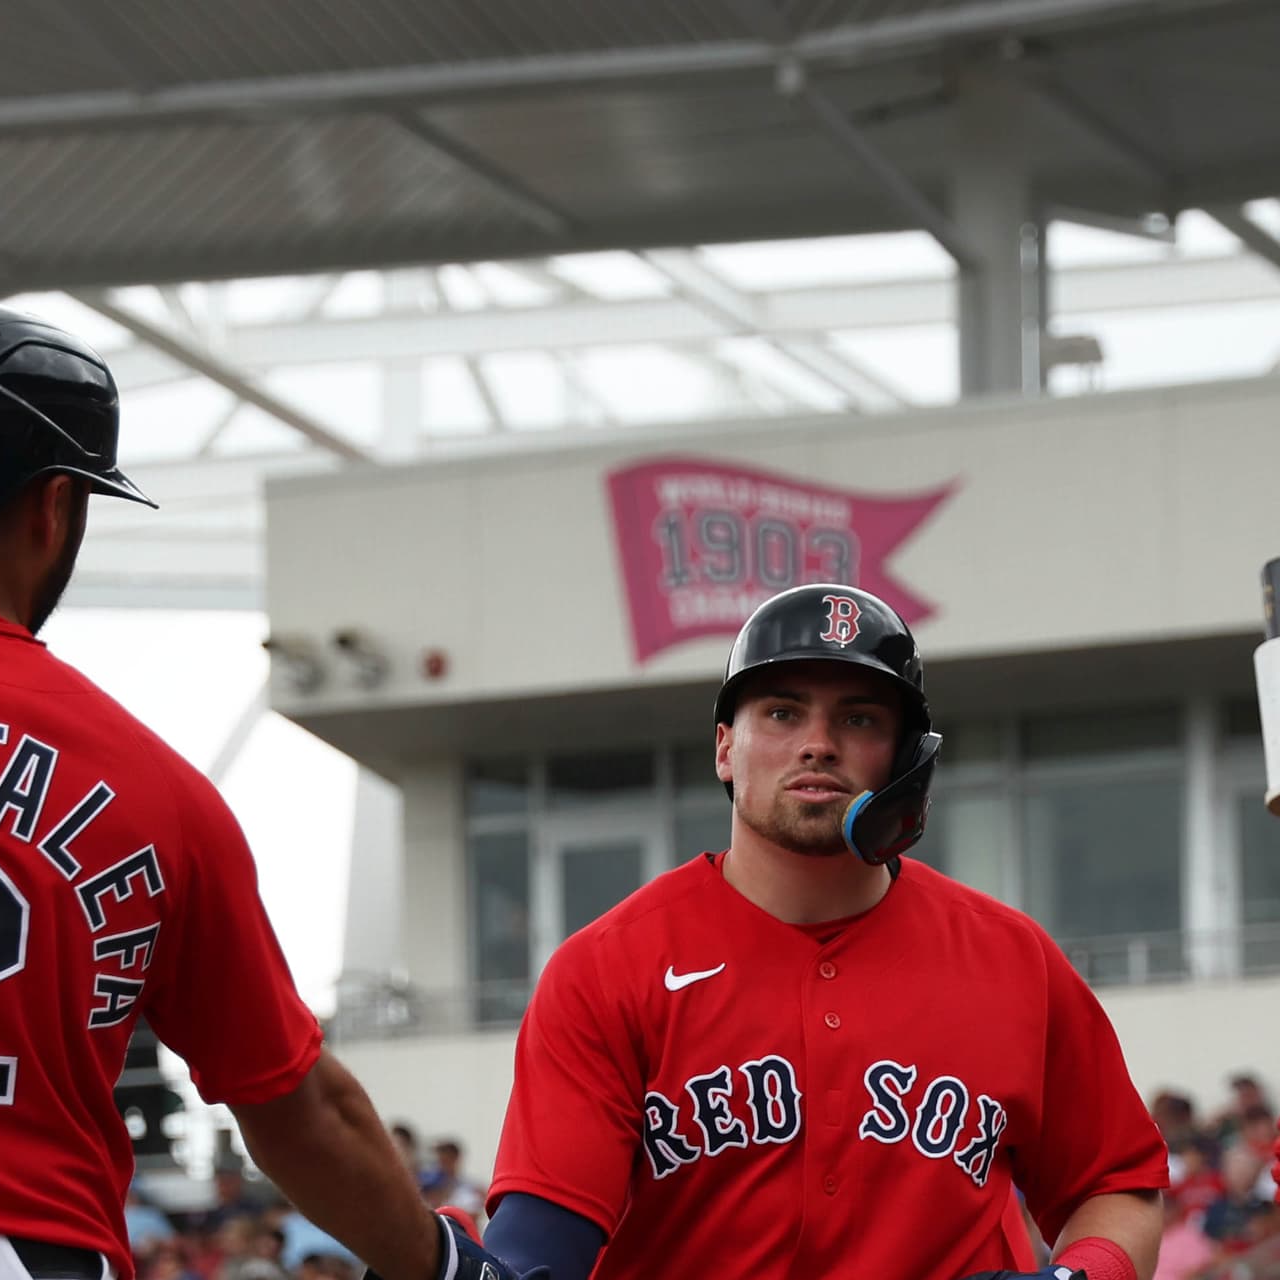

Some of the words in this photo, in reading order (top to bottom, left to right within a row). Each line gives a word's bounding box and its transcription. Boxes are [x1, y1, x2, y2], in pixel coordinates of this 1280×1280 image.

[653, 506, 861, 592] 1903
[820, 594, 862, 644] B
[643, 1054, 803, 1181] RED
[858, 1058, 1008, 1188] SOX
